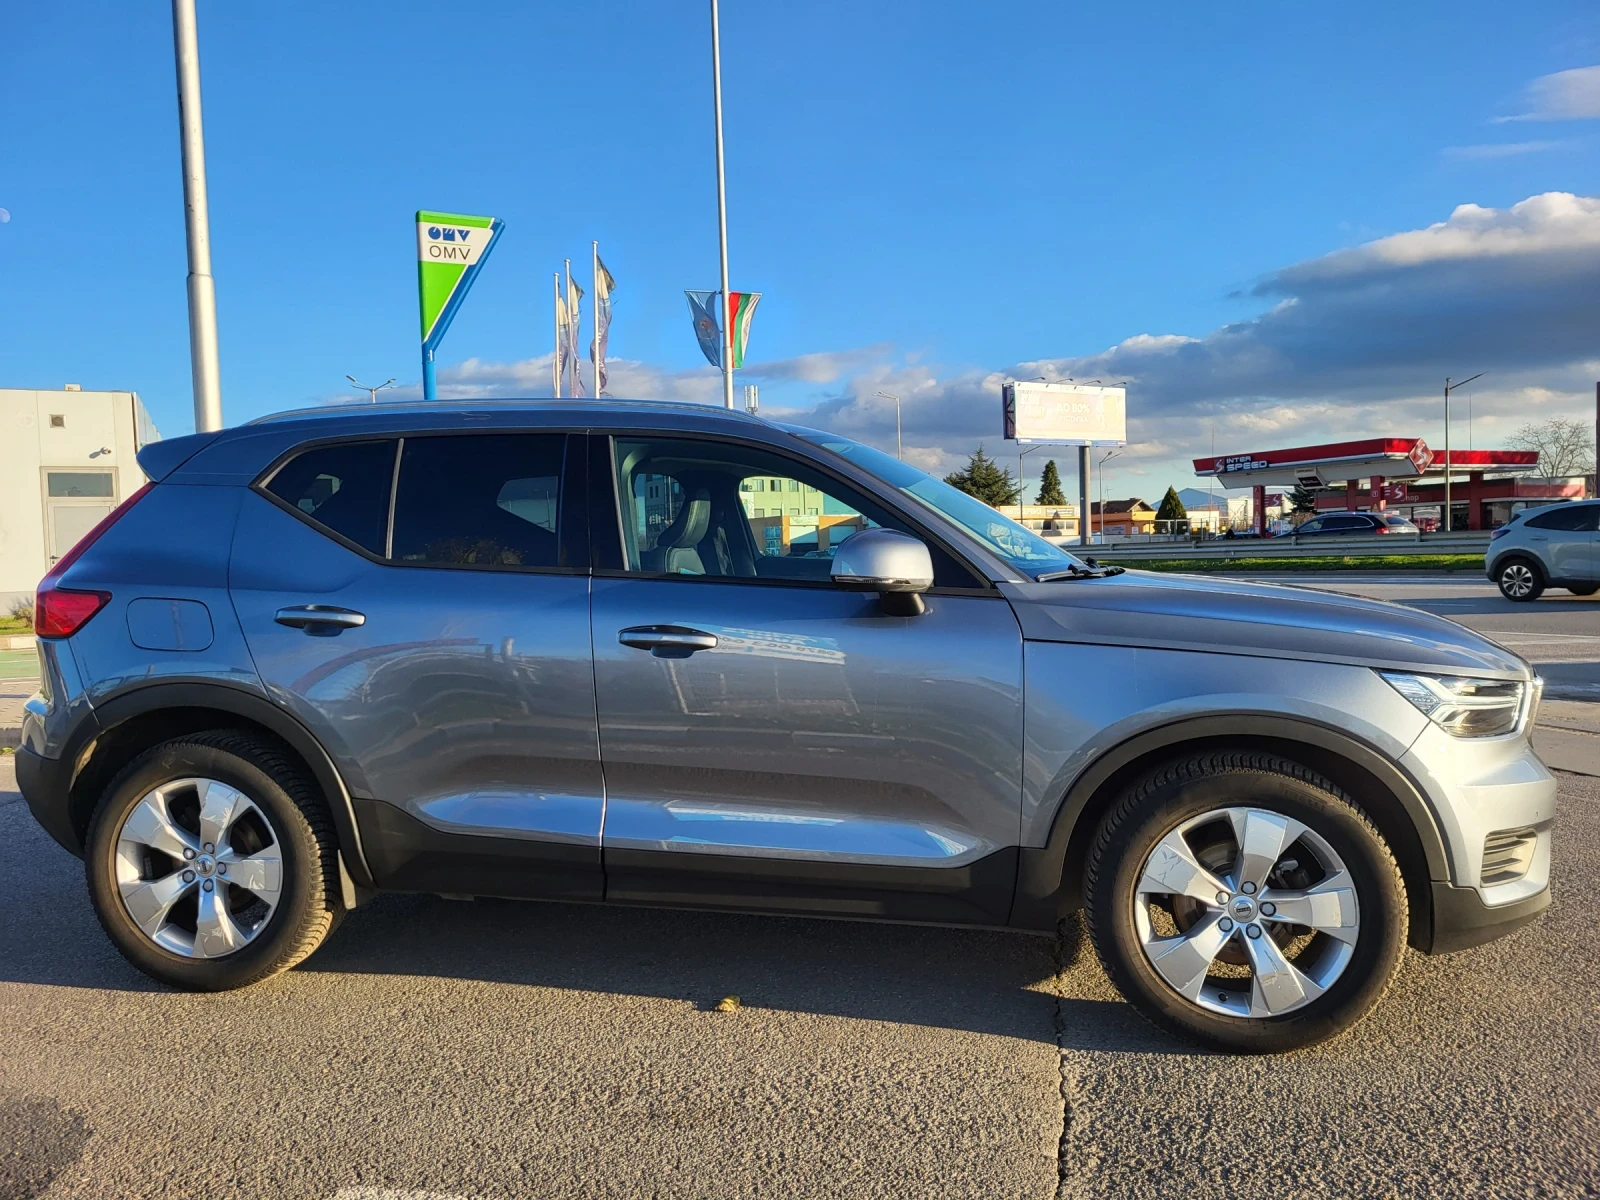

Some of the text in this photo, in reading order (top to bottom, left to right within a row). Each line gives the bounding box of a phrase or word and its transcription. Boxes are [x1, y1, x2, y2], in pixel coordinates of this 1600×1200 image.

[429, 245, 471, 260] OMV
[1071, 403, 1091, 414] 80%
[1226, 455, 1252, 464] INTER
[1226, 460, 1268, 472] SPEED
